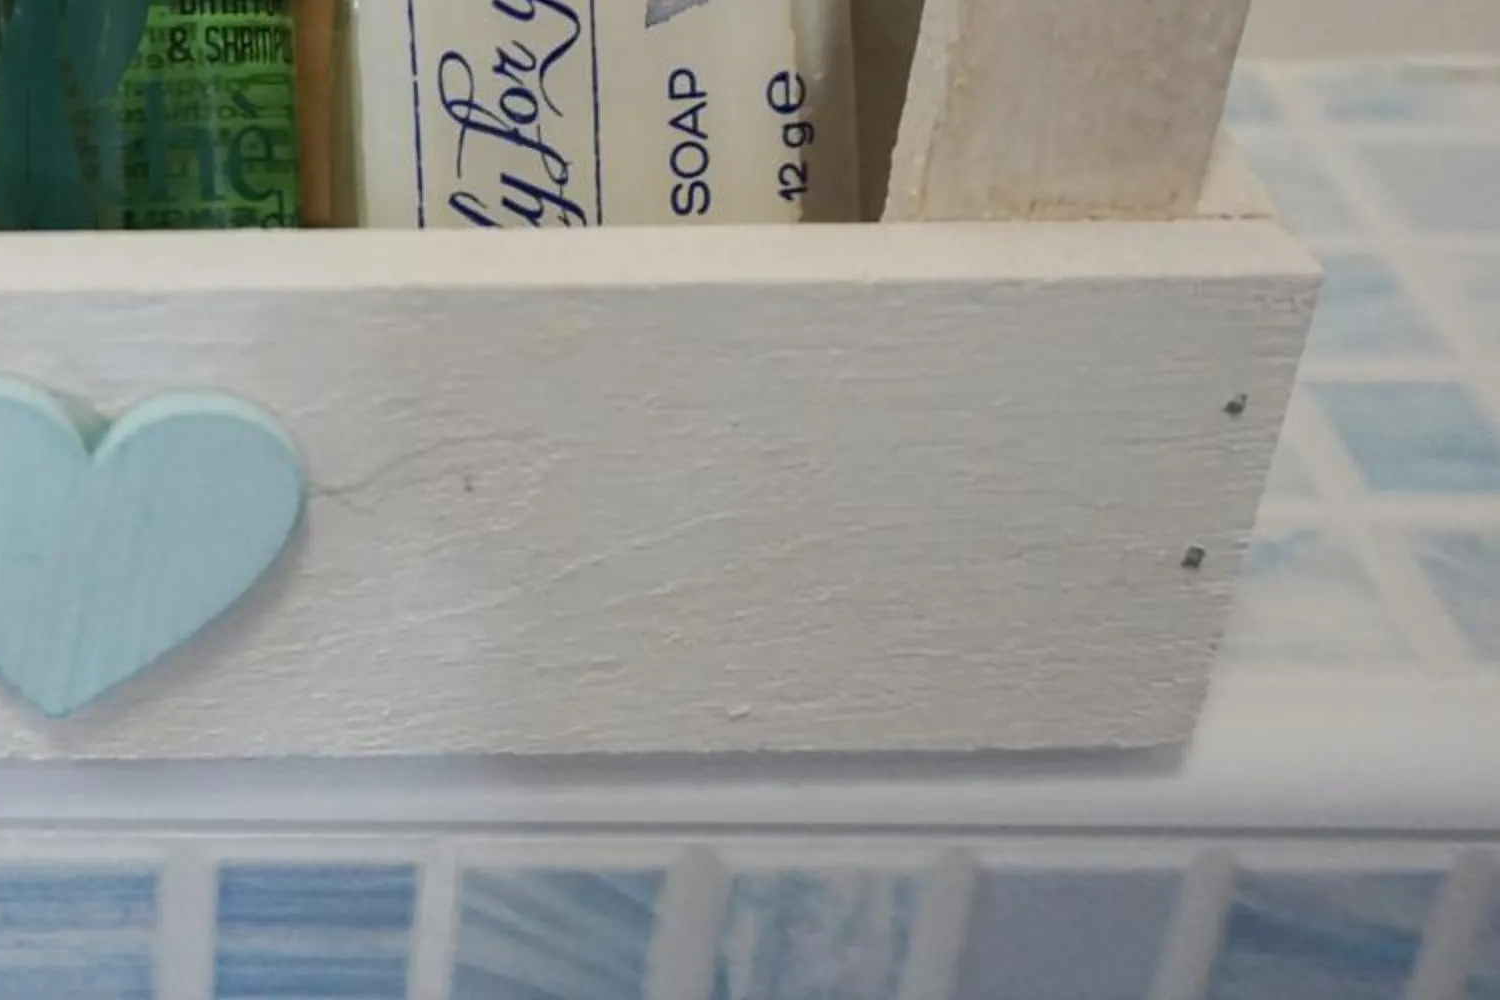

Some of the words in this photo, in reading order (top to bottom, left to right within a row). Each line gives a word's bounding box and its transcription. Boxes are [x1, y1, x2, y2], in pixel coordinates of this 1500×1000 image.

[169, 27, 195, 62] &
[437, 40, 569, 185] for
[668, 68, 711, 216] SOAP
[778, 161, 807, 201] 12
